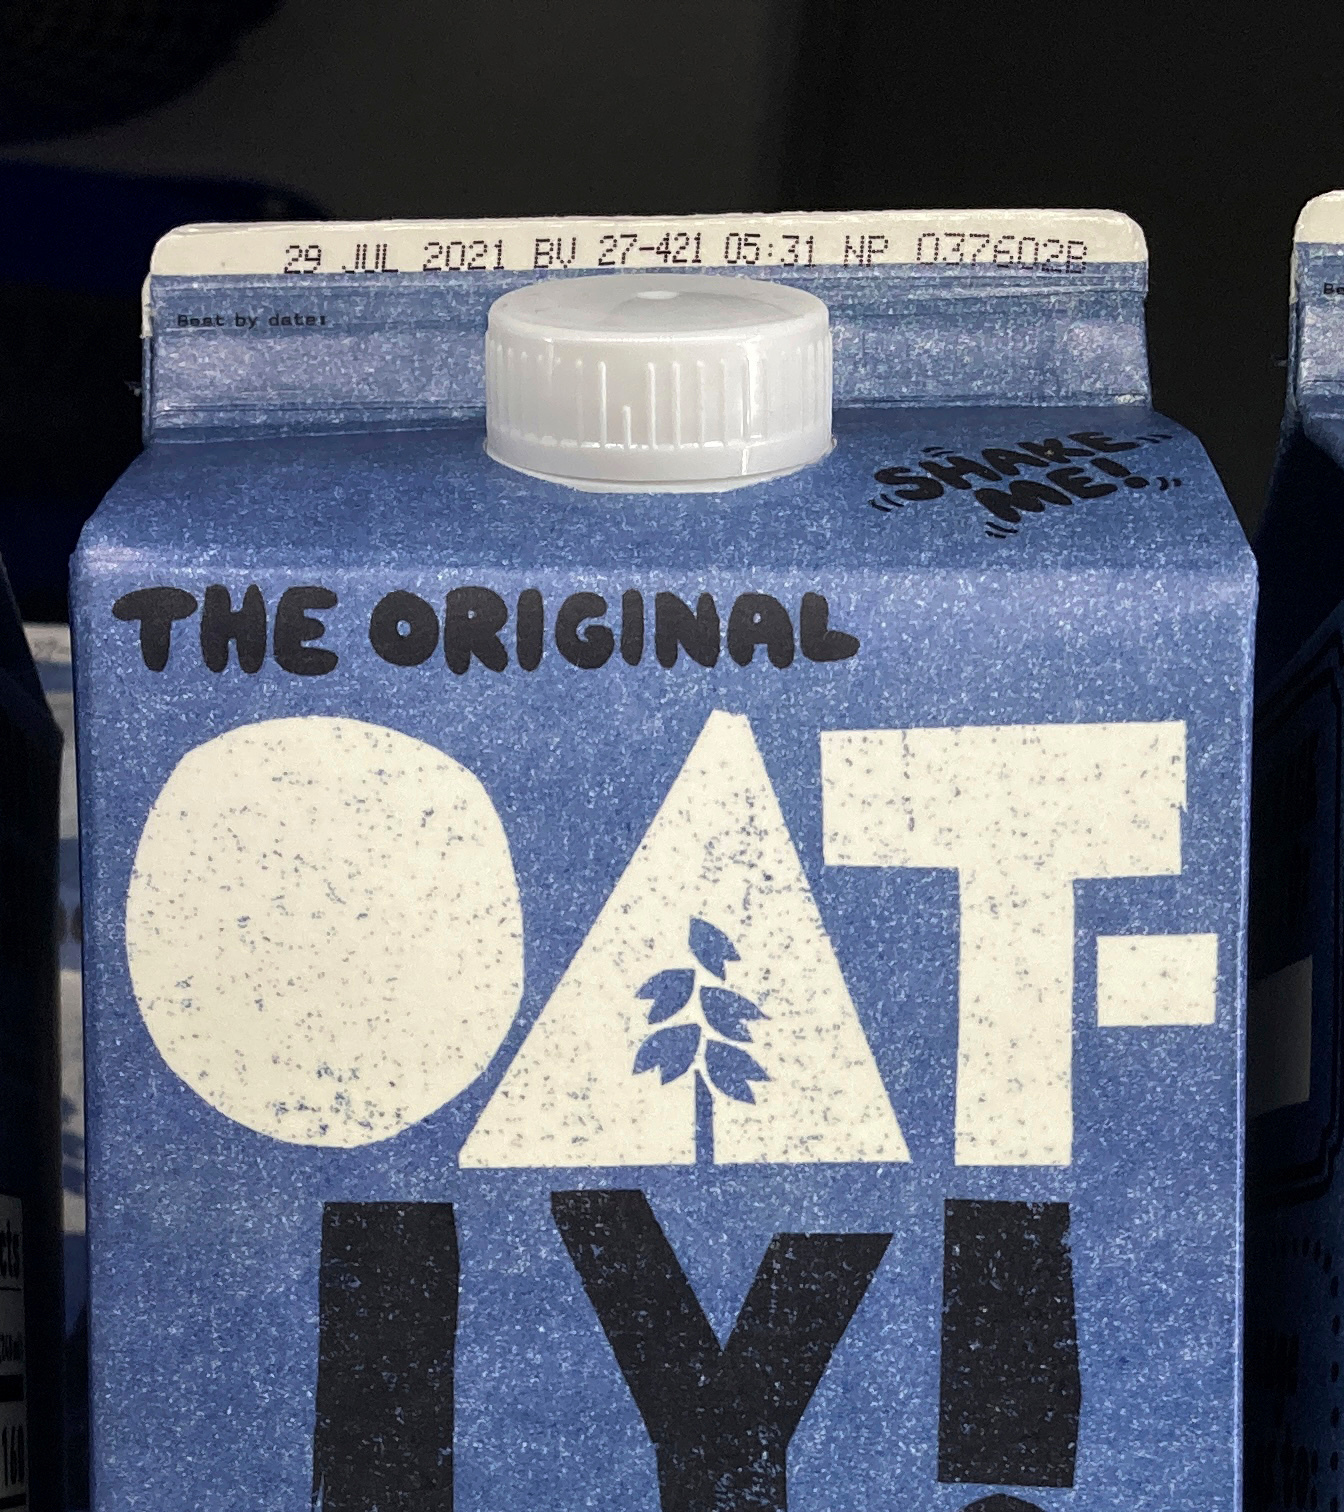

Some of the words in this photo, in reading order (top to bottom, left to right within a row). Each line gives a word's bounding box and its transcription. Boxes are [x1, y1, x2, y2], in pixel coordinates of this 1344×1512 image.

[284, 244, 322, 274] 29
[342, 243, 398, 274] JUL
[423, 240, 504, 272] 2021
[533, 237, 576, 269] BV
[597, 232, 702, 267] 27-421
[724, 233, 816, 267] 05:31
[844, 235, 889, 267] NP
[235, 312, 257, 329] by
[874, 431, 1138, 501] SHAKE
[973, 457, 1149, 523] ME!
[112, 584, 338, 676] THE
[368, 587, 860, 675] ORIGINAL
[126, 709, 1218, 1168] OAT-
